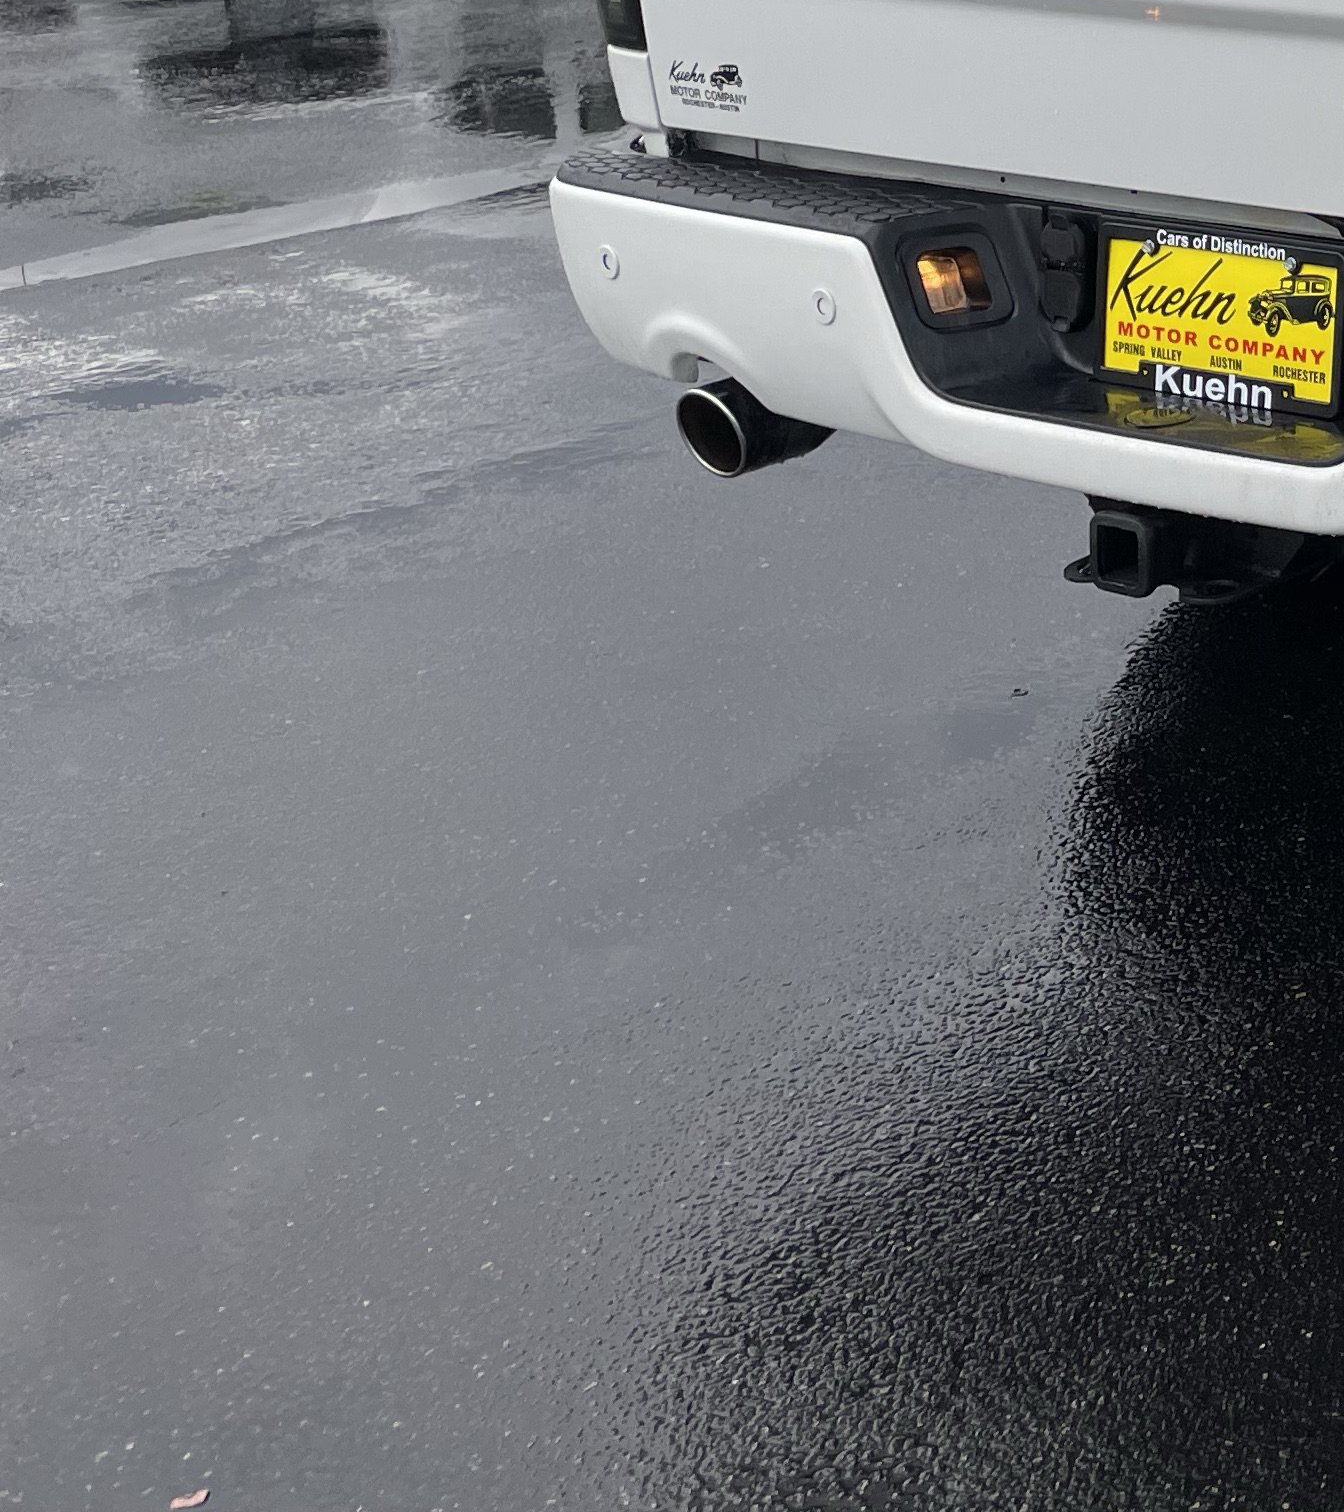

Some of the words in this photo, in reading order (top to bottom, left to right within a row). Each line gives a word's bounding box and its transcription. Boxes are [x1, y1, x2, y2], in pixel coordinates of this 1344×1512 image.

[668, 60, 706, 84] Kuehn
[670, 85, 701, 99] MOTOR
[704, 89, 747, 105] COMPANY
[1156, 229, 1189, 249] Cars
[1192, 233, 1208, 250] of
[1210, 236, 1286, 261] Distinction
[1110, 246, 1237, 325] Kuehn
[1113, 341, 1145, 357] SPRING
[1151, 347, 1182, 362] VALLEY
[1209, 355, 1243, 372] AUSTIN
[1273, 365, 1326, 384] ROCHESTER
[1117, 321, 1198, 346] MOTOR
[1208, 335, 1325, 365] COMPANY
[1154, 364, 1272, 410] Kuehn
